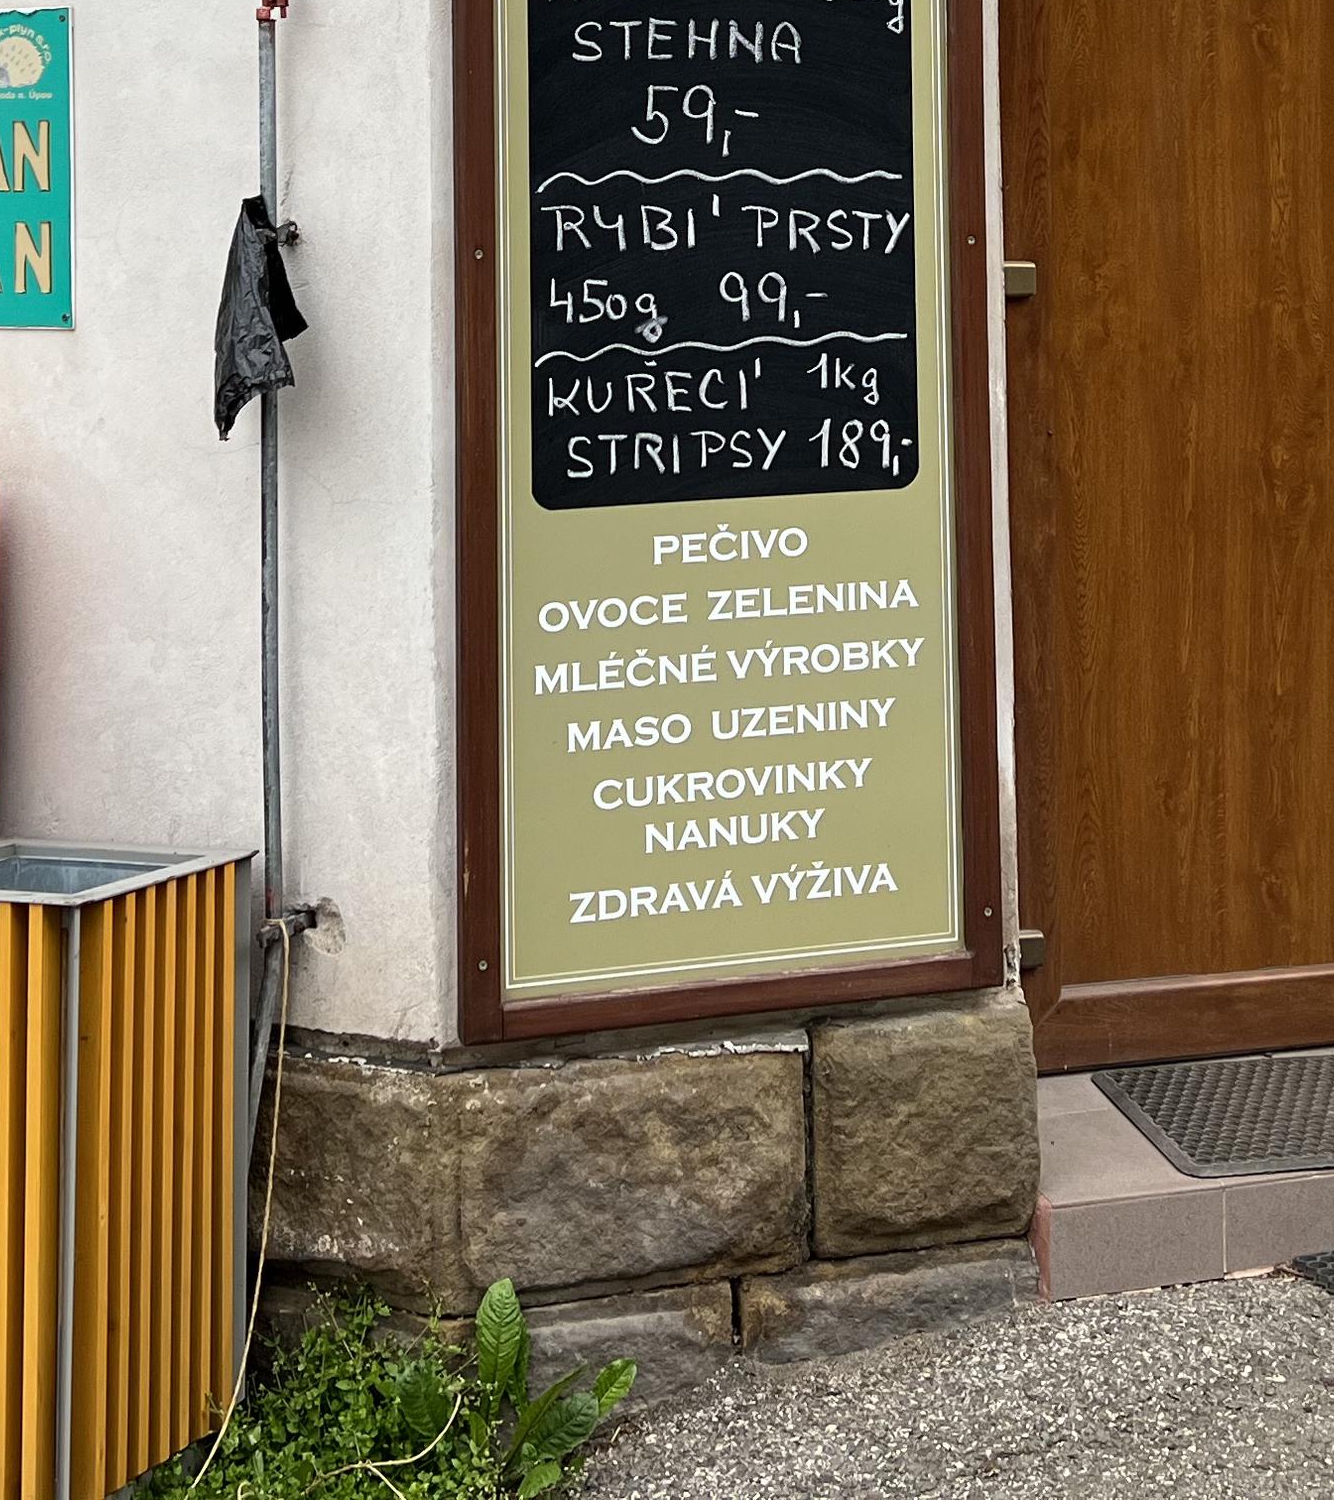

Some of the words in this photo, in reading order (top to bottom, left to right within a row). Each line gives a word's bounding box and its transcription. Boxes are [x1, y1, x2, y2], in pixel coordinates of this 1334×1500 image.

[572, 18, 803, 65] STEHNA
[630, 84, 760, 157] 59,-
[742, 203, 912, 255] PRSTY
[549, 277, 668, 343] 450g
[719, 271, 829, 328] 99,-
[566, 428, 786, 478] STRIPSY
[652, 522, 809, 565] PEČIVO
[537, 592, 689, 634] OVOCE
[706, 578, 920, 622] ZELENINA
[534, 644, 718, 696] MLÉČNÉ
[726, 636, 926, 681] VÝROBKY
[566, 712, 693, 754] MASO
[711, 696, 897, 741] UZENINY
[592, 756, 874, 811] CUKROVINKY
[643, 808, 826, 855] NANUKY
[569, 870, 744, 925] ZDRAVÁ
[750, 859, 899, 906] VÝŽIVA
